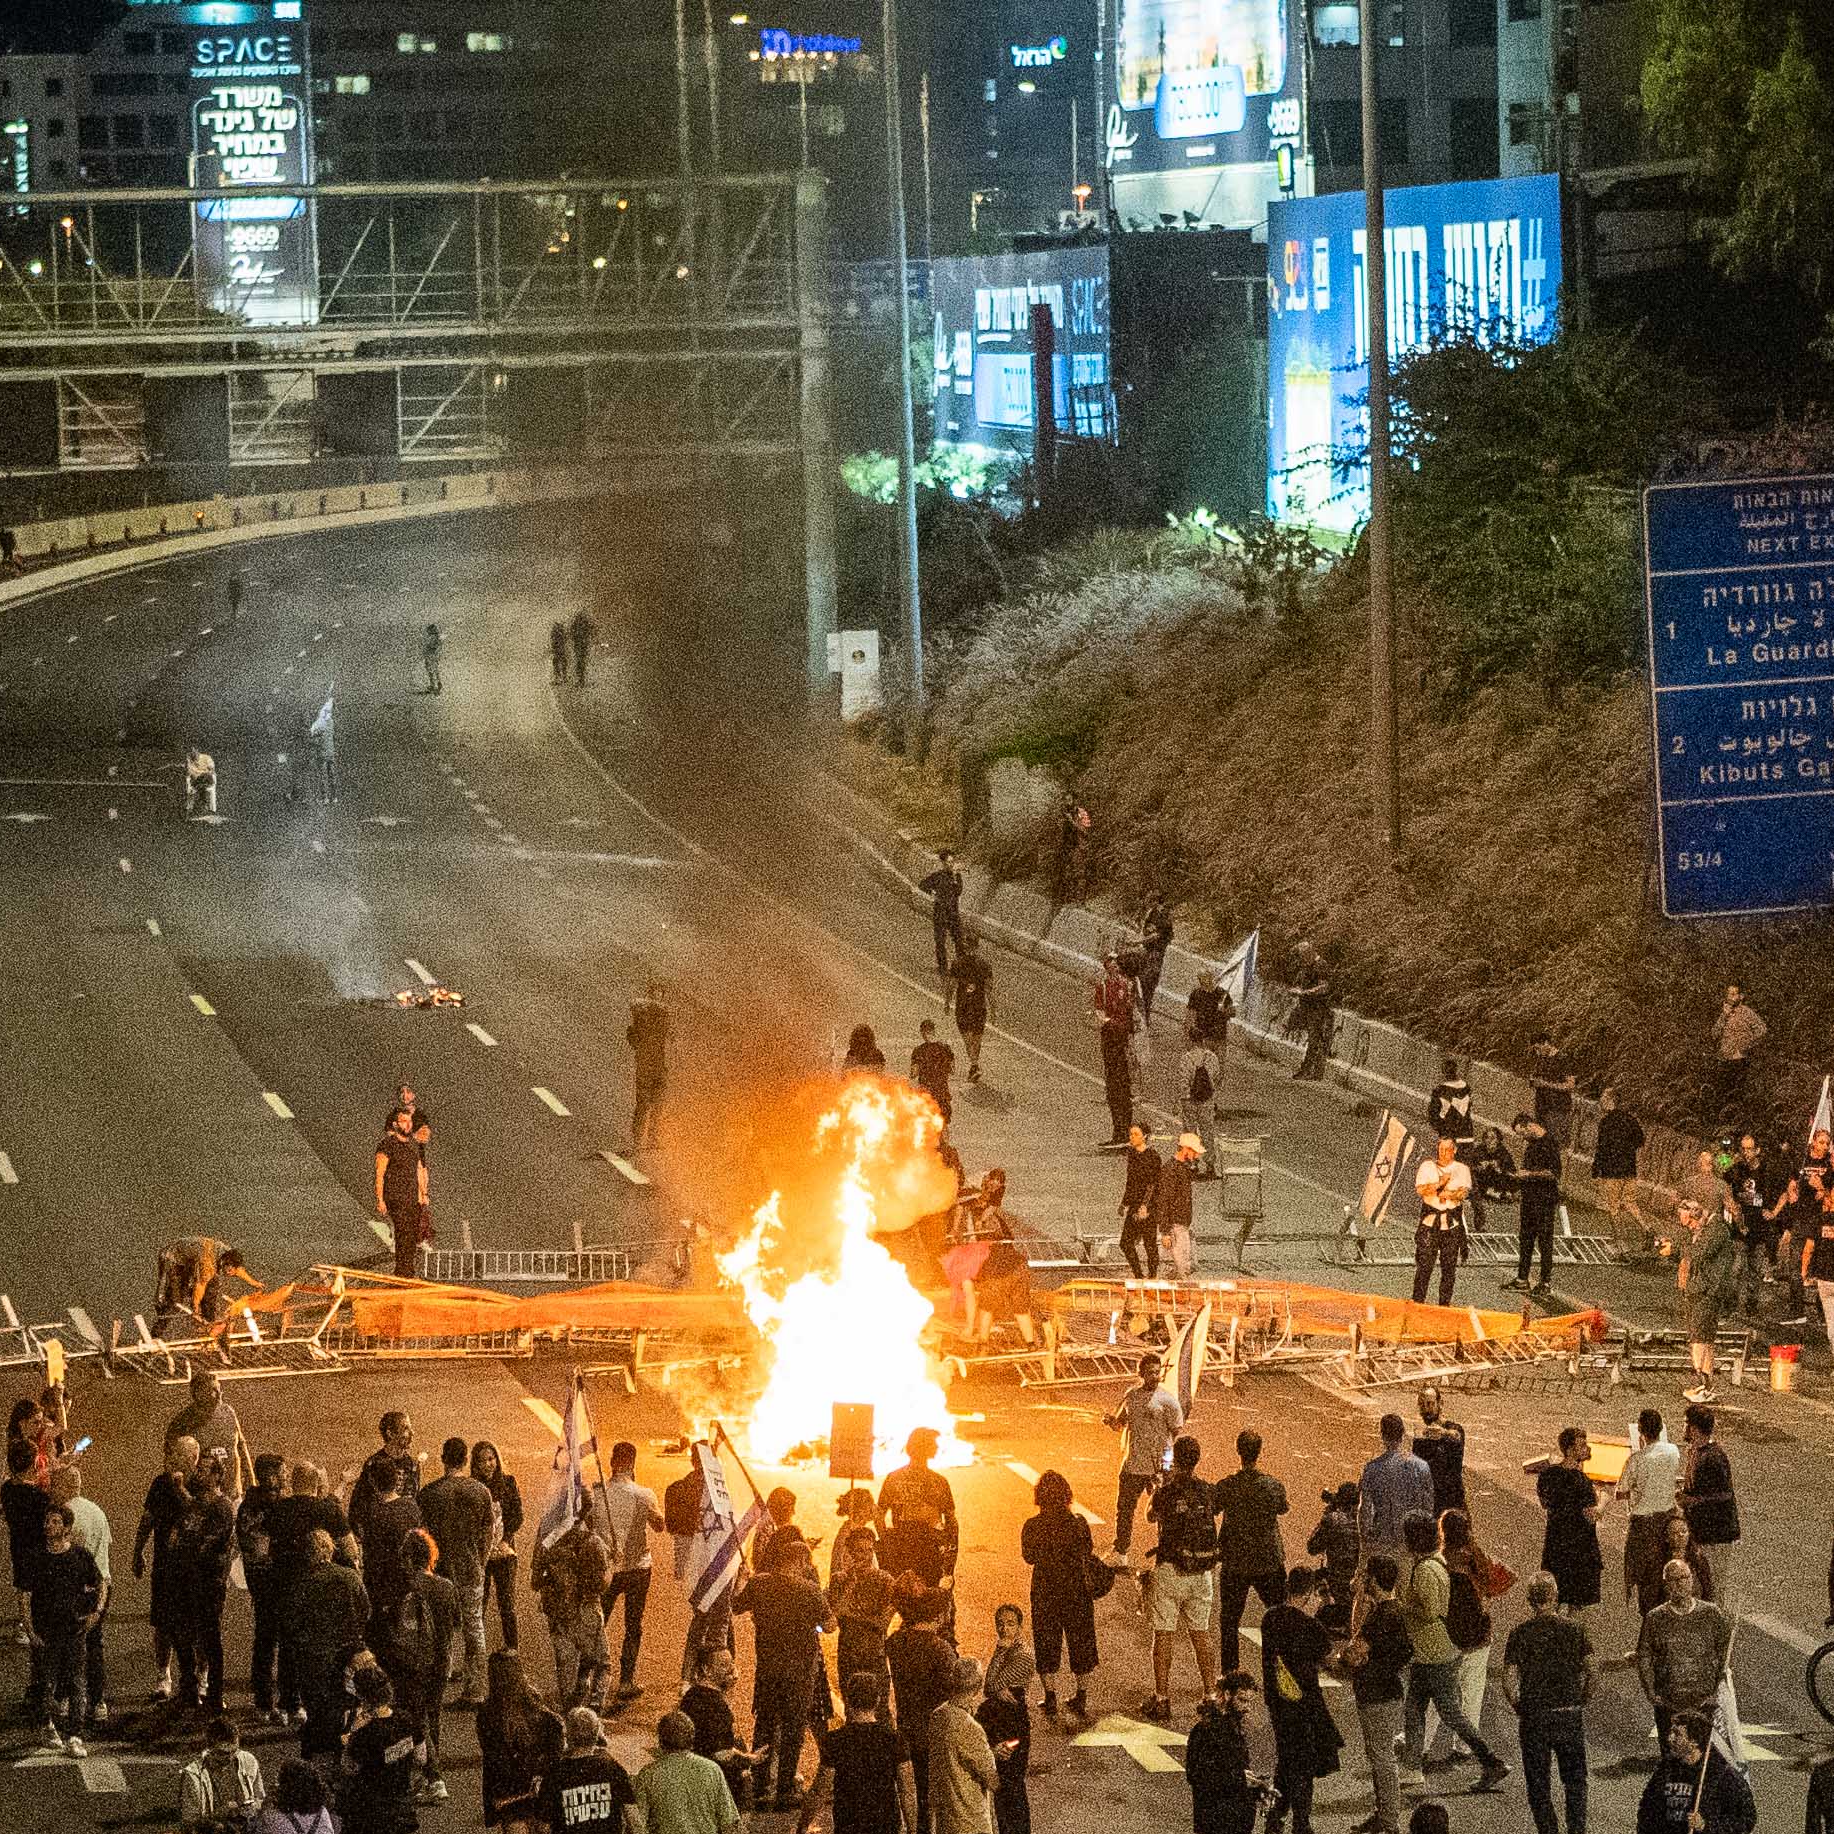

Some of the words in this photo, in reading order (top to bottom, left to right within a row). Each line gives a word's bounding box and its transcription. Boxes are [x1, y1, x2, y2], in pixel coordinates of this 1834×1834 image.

[196, 37, 292, 63] SPACE
[211, 85, 283, 108] משרד
[258, 107, 297, 131] של
[211, 132, 286, 156] במחיר
[1733, 490, 1791, 510] הבאות
[1747, 536, 1799, 553] NEXT
[1703, 583, 1795, 608] גוורדיה
[1666, 620, 1676, 640] 1
[1707, 646, 1738, 666] La
[1741, 695, 1817, 720] גלויות
[1671, 735, 1685, 754] 2
[1699, 762, 1784, 784] Kibuts
[562, 1783, 612, 1807] בחירות
